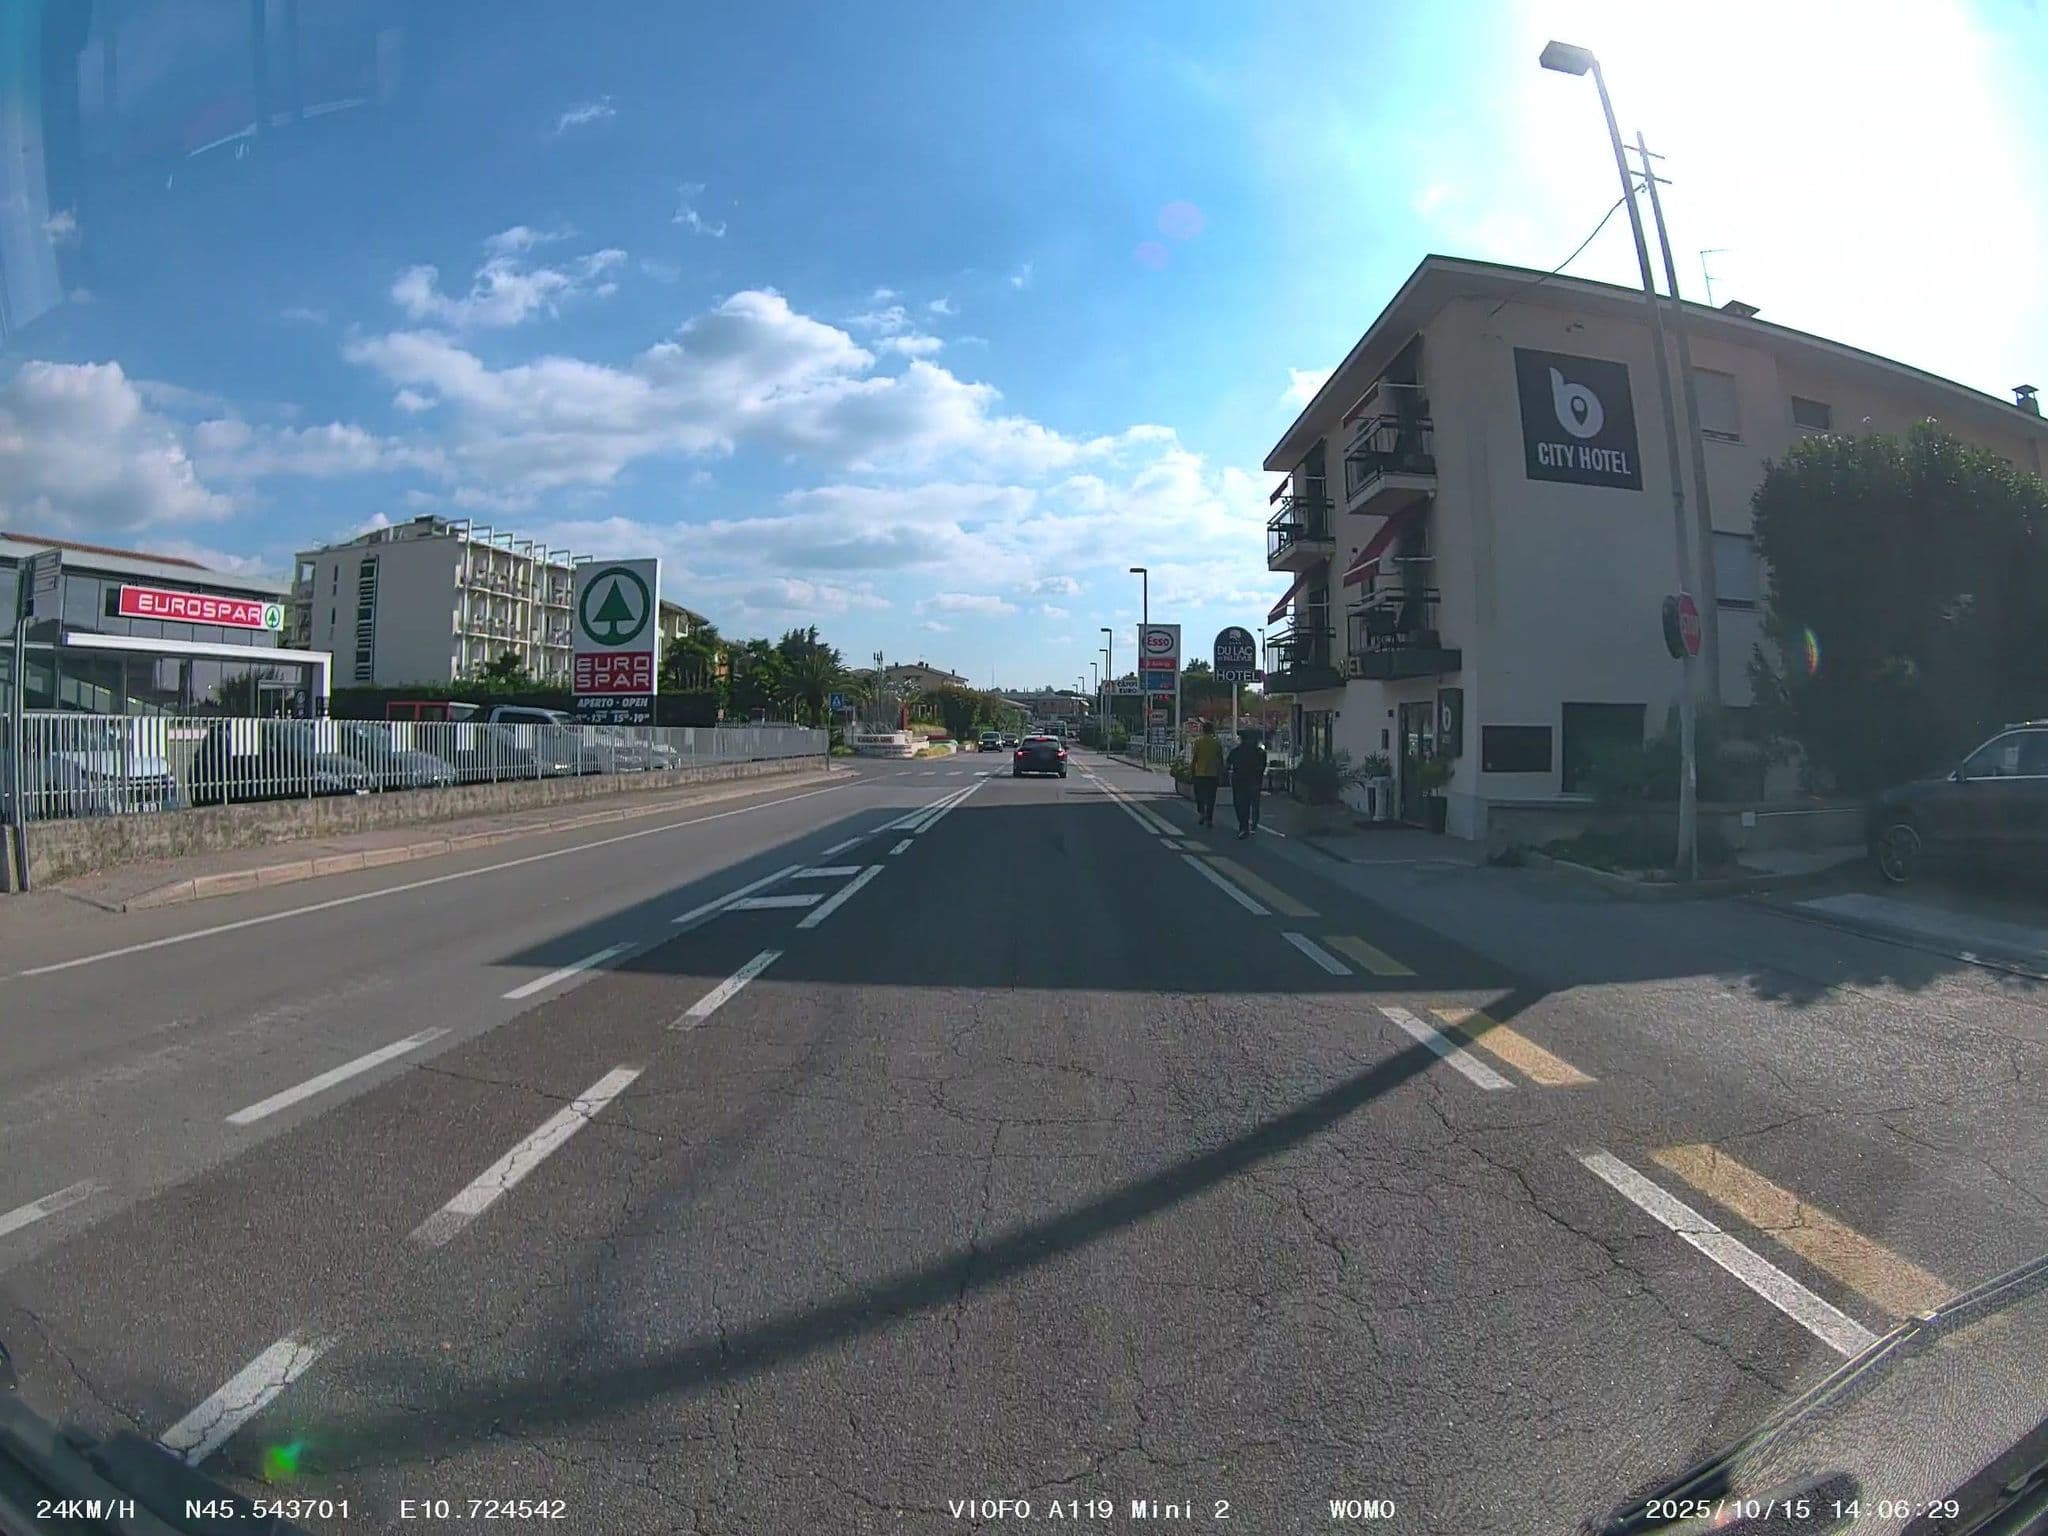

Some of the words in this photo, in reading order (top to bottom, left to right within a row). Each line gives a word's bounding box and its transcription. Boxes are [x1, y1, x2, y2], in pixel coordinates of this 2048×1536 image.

[1537, 442, 1574, 468] CITY
[1578, 446, 1632, 475] HOTEL
[138, 593, 261, 623] EUROSPAR
[1217, 645, 1231, 656] DU
[1234, 645, 1253, 656] LAC
[576, 656, 650, 672] EURO
[576, 672, 650, 689] SPAR
[1216, 670, 1260, 681] HOTEL
[577, 698, 614, 708] APERTO
[622, 697, 648, 707] OPEN
